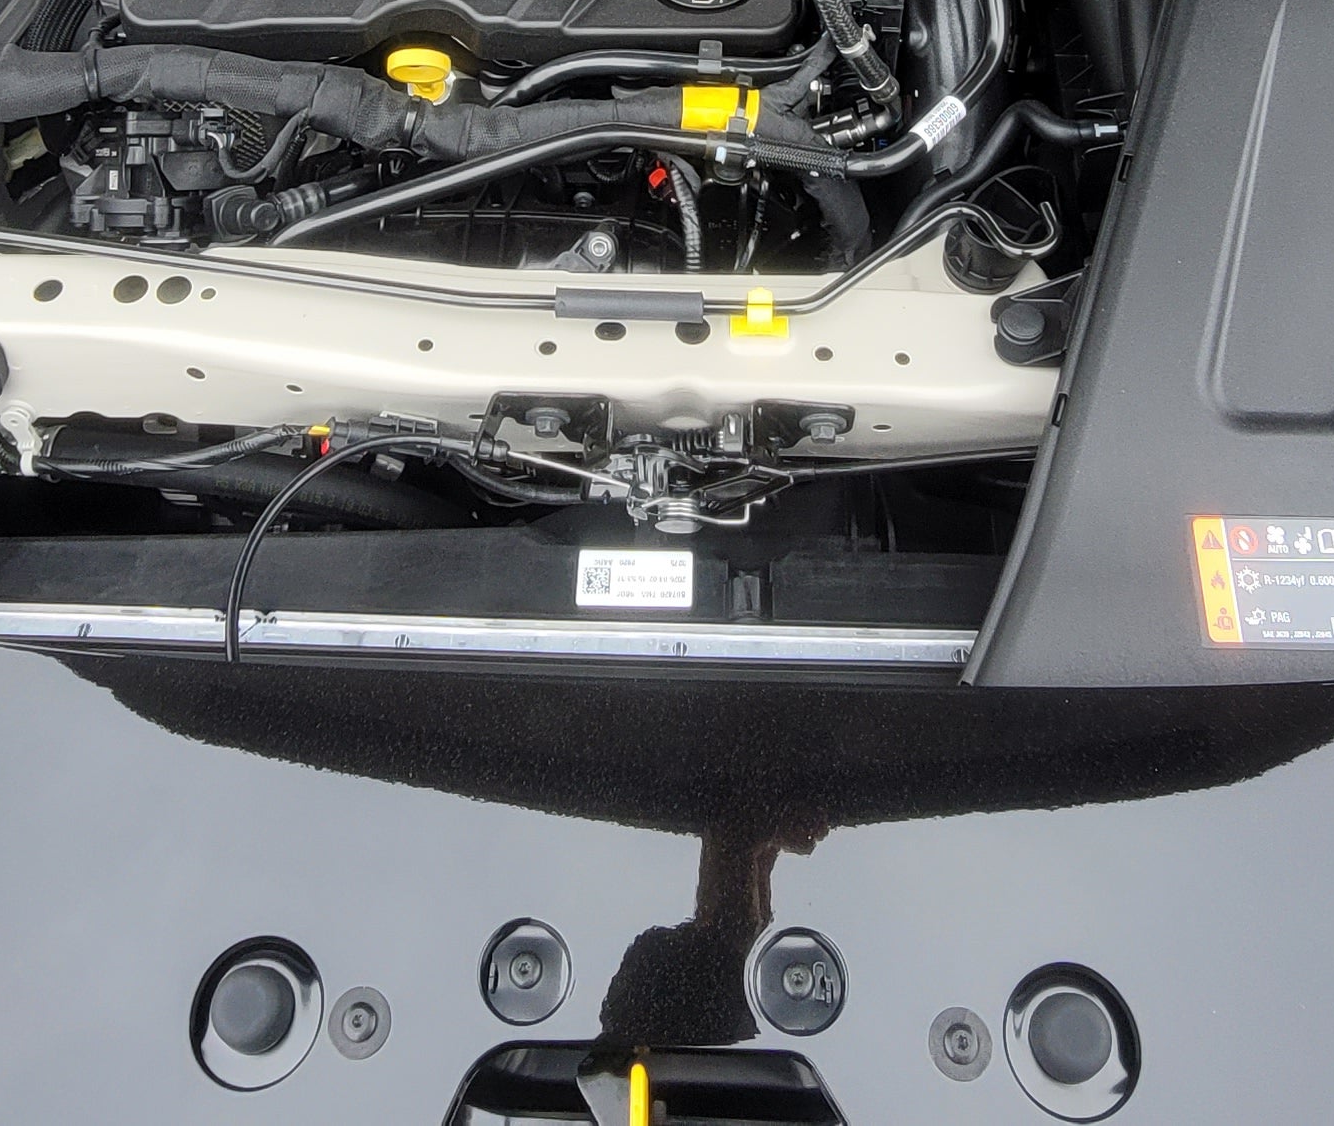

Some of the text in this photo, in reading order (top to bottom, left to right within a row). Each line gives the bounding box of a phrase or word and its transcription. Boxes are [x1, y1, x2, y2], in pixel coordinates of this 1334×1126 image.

[1267, 544, 1289, 554] AUTO
[1263, 574, 1306, 588] R-1234yf
[1270, 611, 1291, 623] PAG
